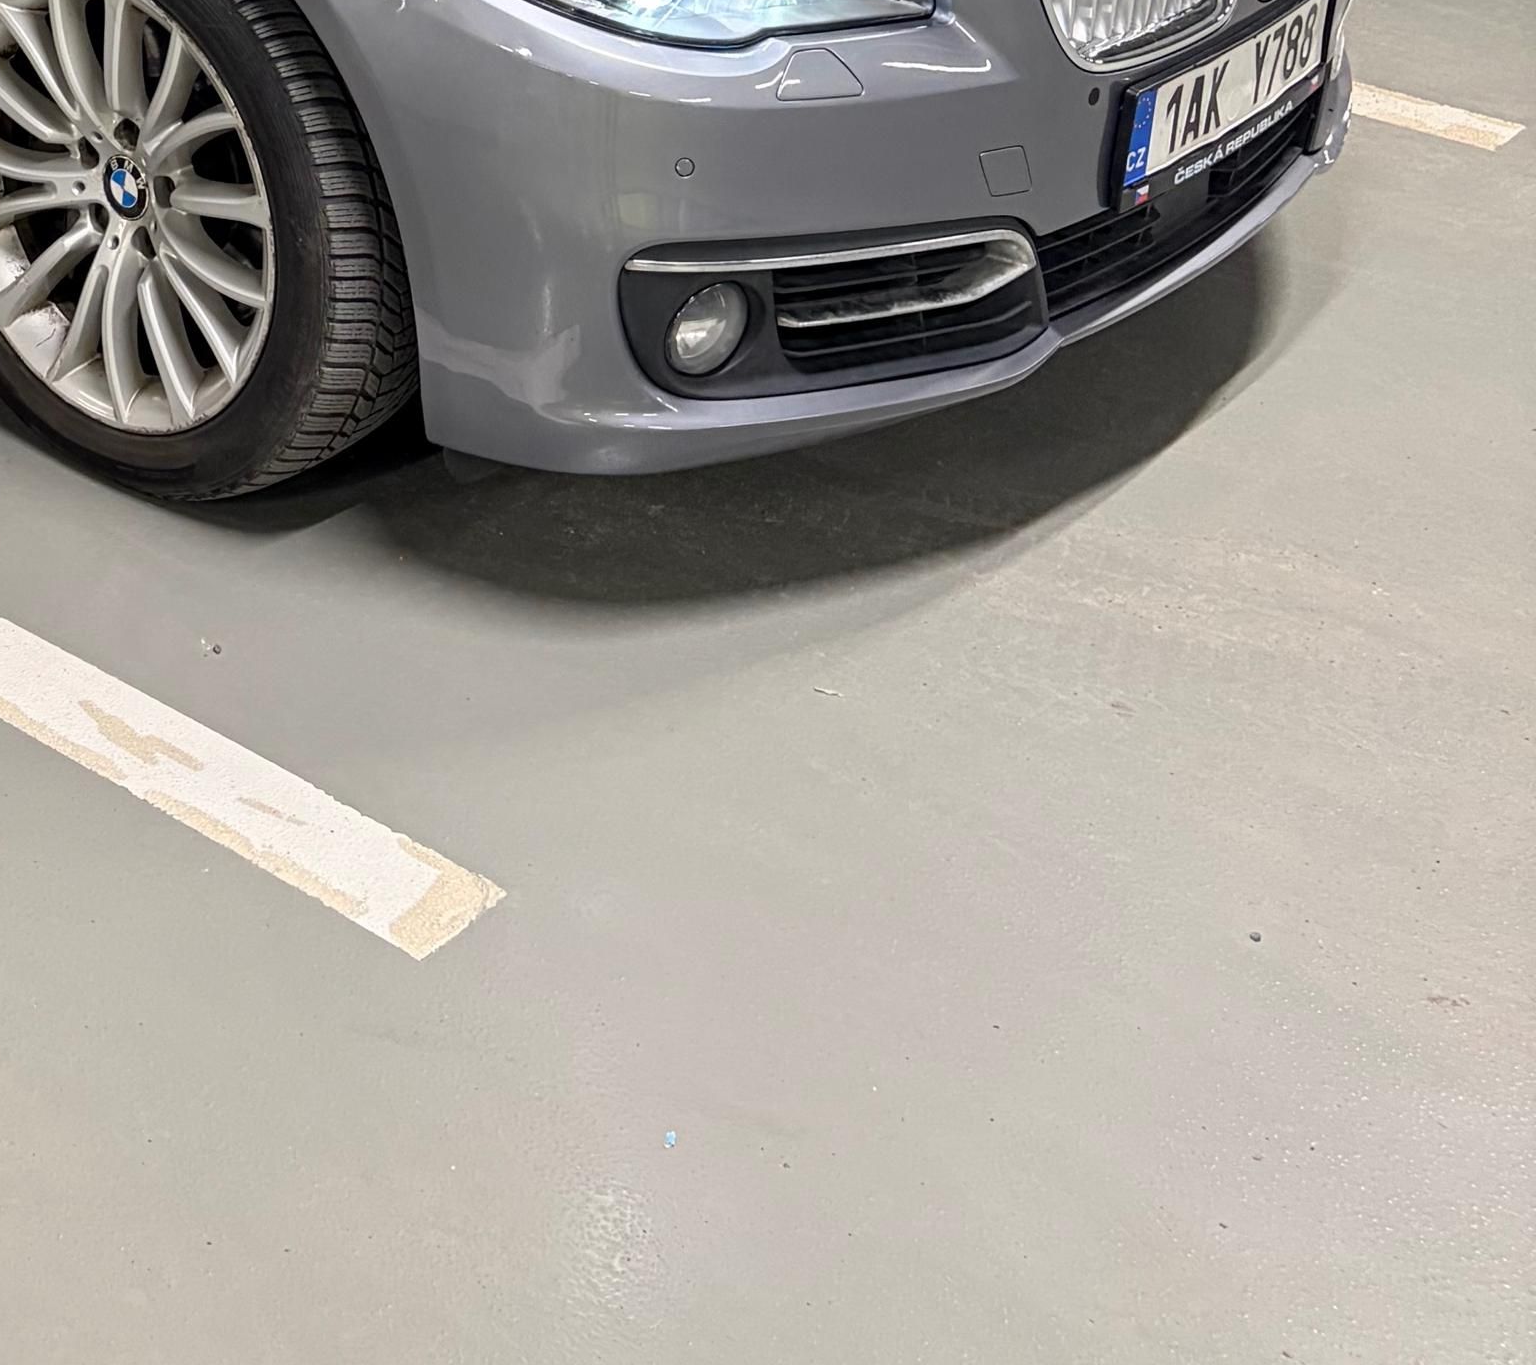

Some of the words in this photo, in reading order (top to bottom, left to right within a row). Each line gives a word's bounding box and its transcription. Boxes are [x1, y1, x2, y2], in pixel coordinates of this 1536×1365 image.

[1166, 60, 1230, 154] 1AK
[1252, 3, 1318, 105] Y788
[1126, 147, 1145, 172] CZ
[1174, 144, 1223, 185] ČESKÁ
[1225, 100, 1294, 155] REPUBLIKA
[110, 158, 145, 189] BMW
